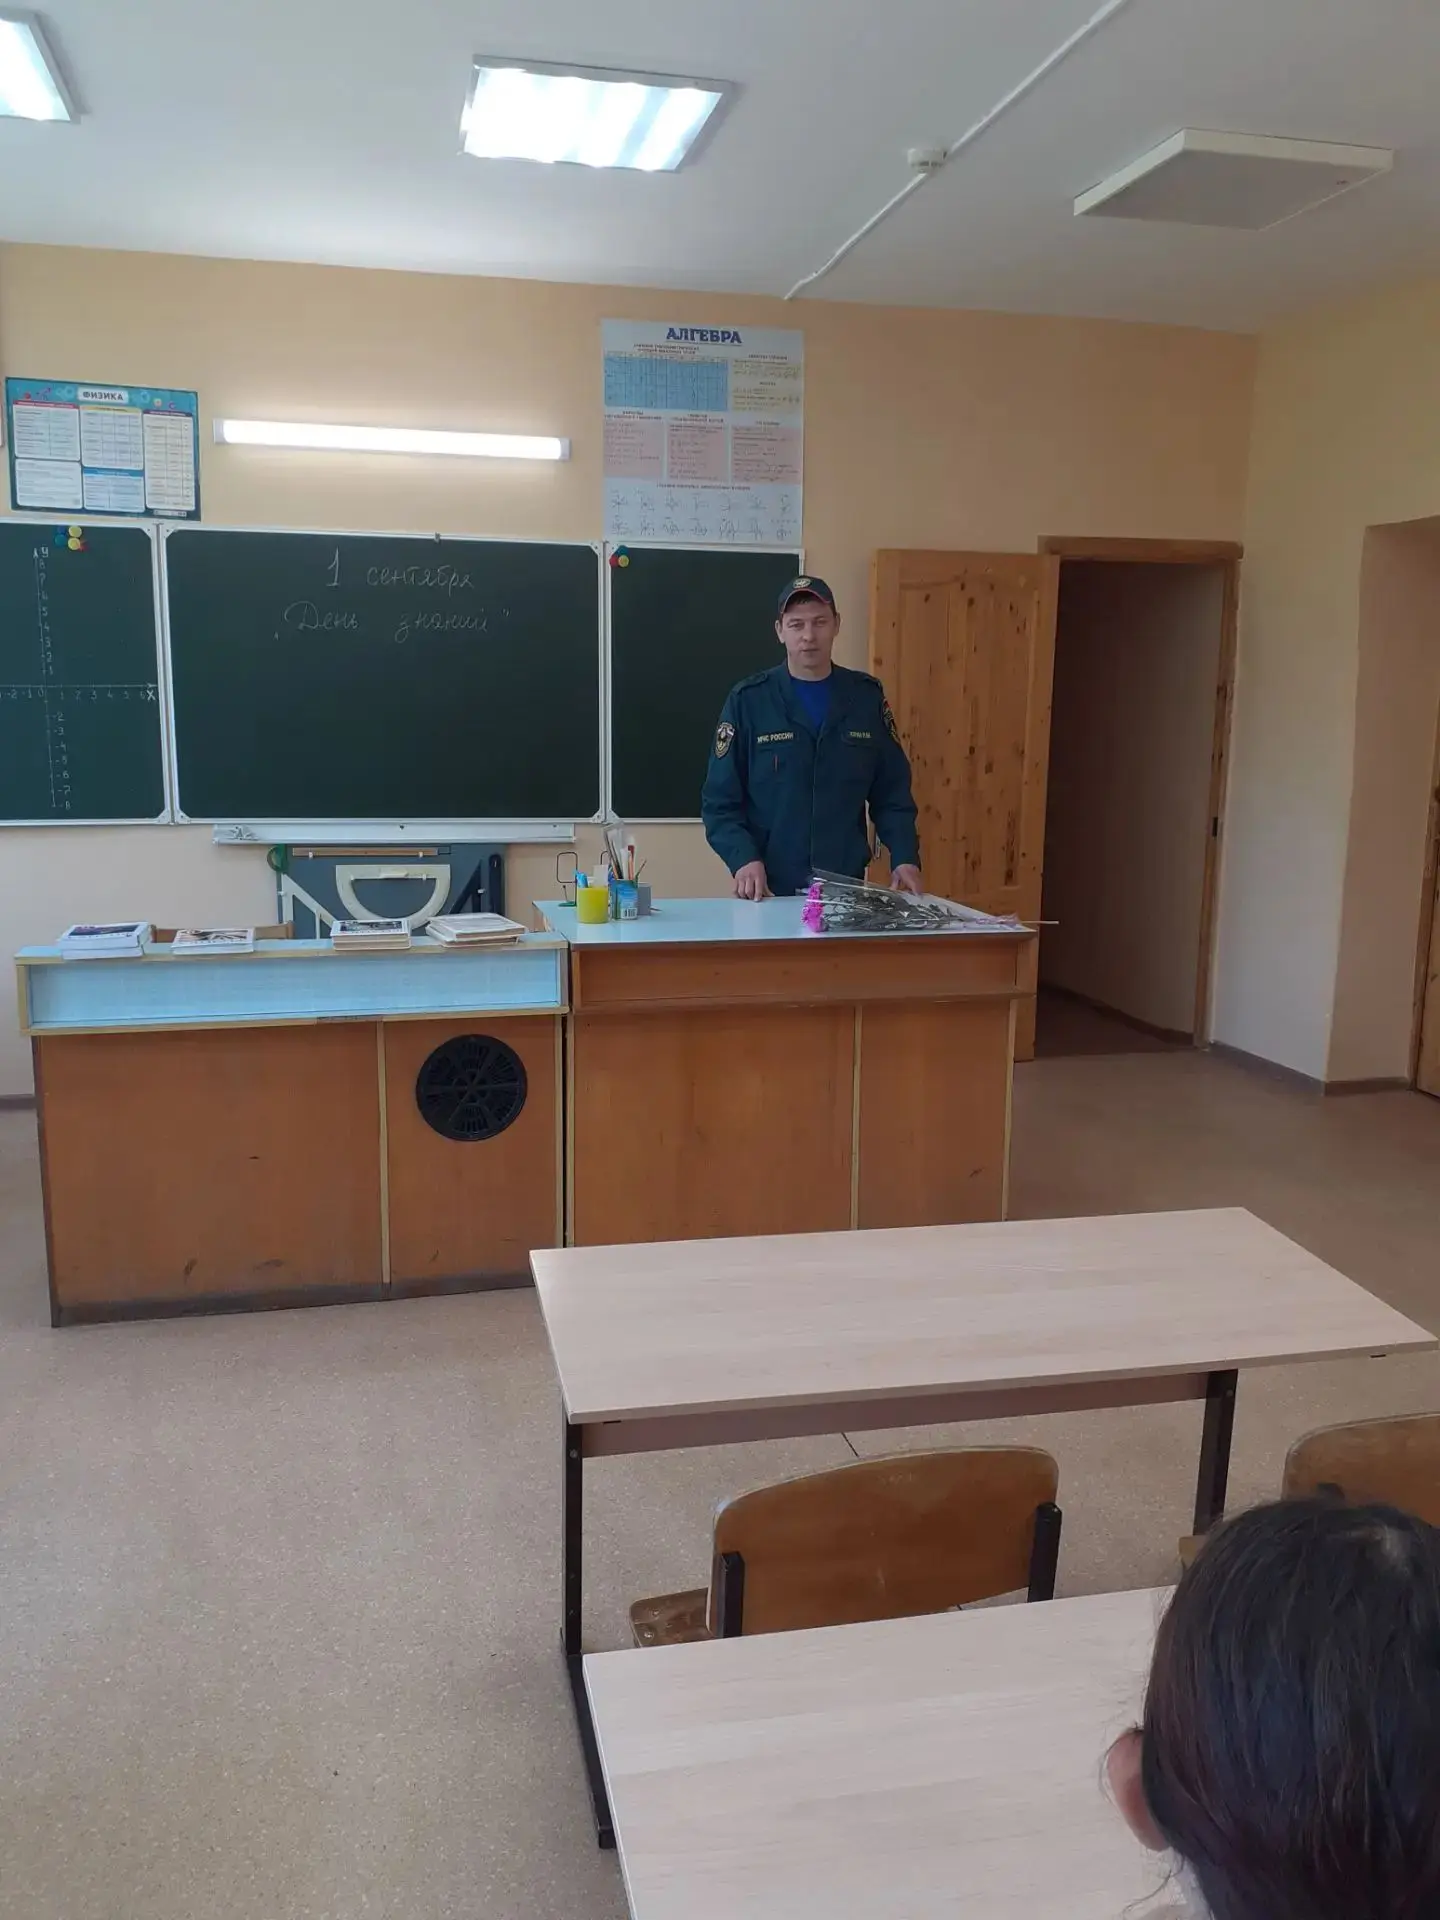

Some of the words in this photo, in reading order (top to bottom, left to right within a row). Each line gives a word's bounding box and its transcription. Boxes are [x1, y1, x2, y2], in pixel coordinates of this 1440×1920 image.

[666, 327, 743, 344] АЛГЕБРА
[82, 391, 124, 401] ФИЗИКА
[326, 547, 340, 587] 1
[366, 564, 474, 597] сентября
[770, 731, 794, 742] РОССИИ
